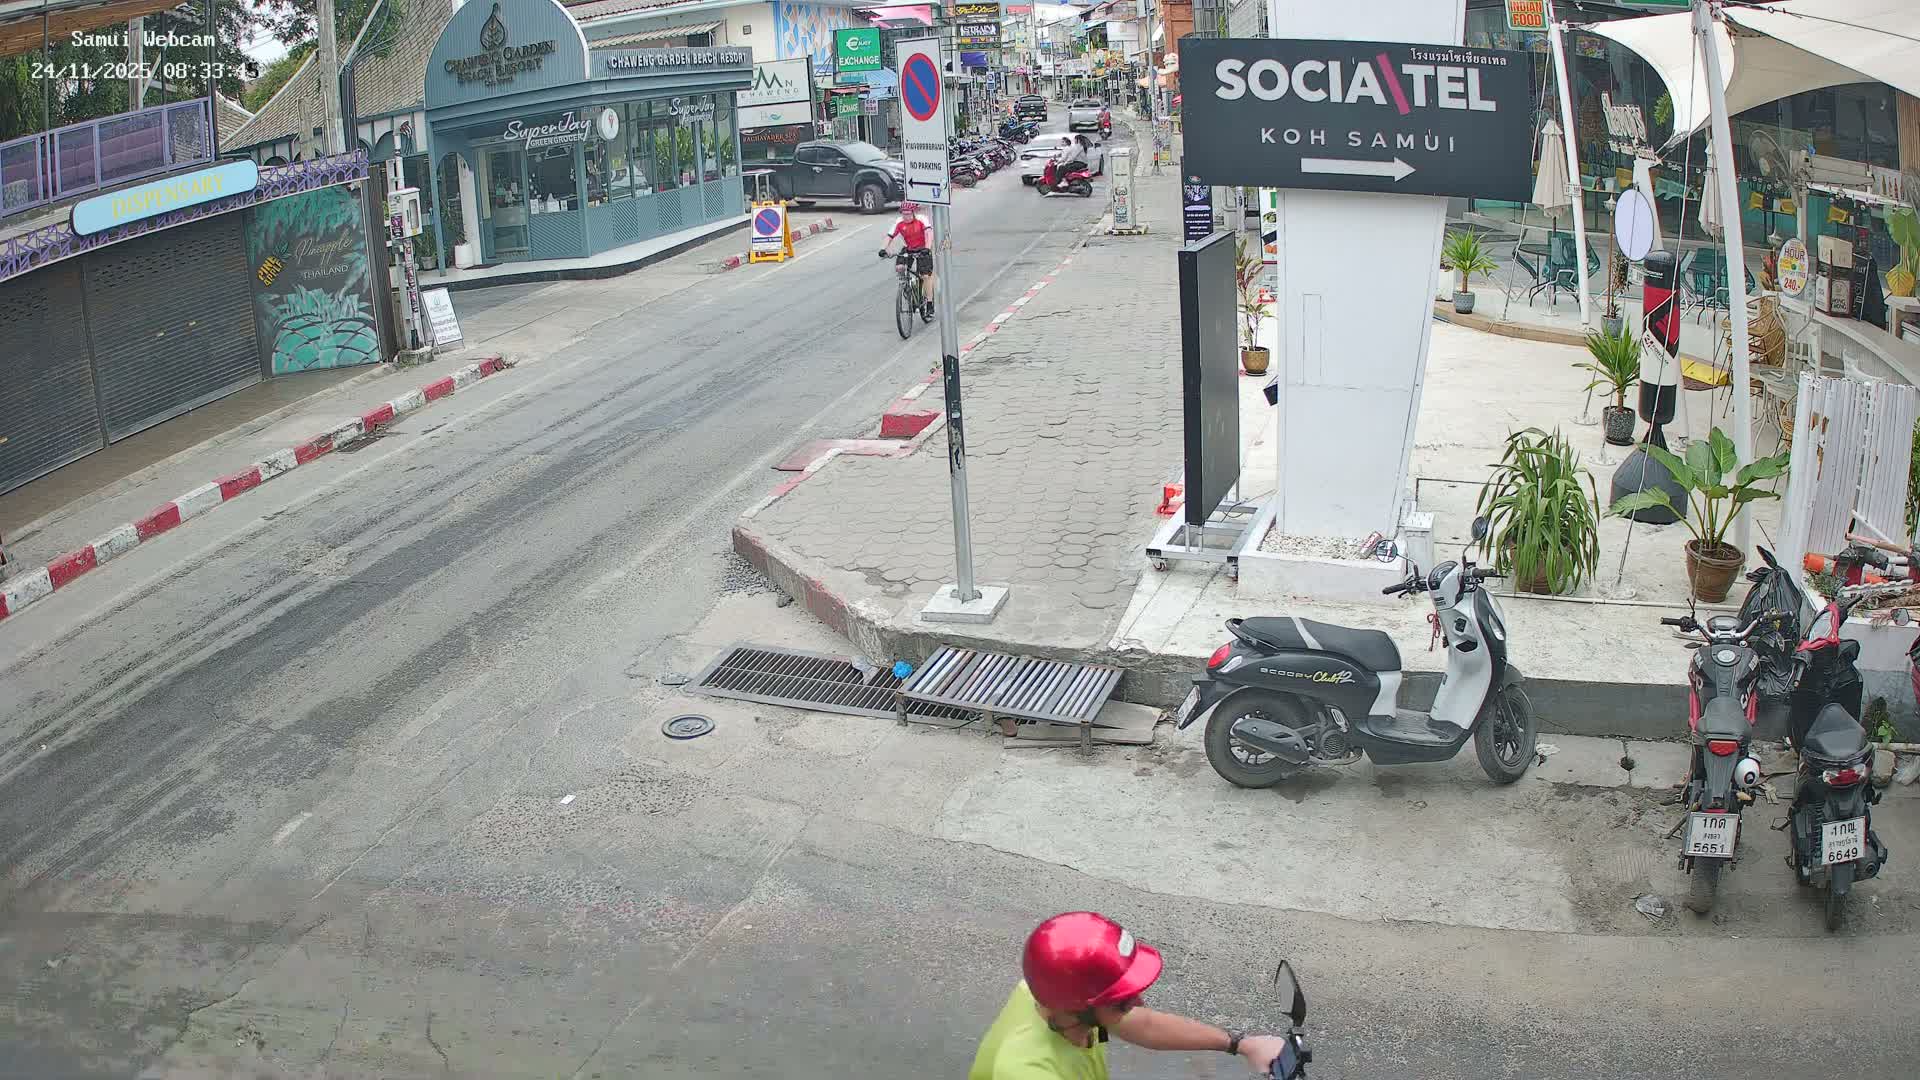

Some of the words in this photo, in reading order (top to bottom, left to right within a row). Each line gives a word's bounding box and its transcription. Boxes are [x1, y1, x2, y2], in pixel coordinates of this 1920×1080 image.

[1512, 13, 1542, 26] FOOD
[502, 40, 555, 60] GARDEN
[496, 58, 543, 77] RESORT
[611, 54, 655, 69] CHAWENG
[657, 52, 690, 66] GARDEN
[692, 51, 718, 65] BEACH
[720, 50, 746, 63] RESORT
[839, 55, 880, 66] EXCHANGE
[1260, 128, 1326, 146] KOH
[909, 161, 917, 170] NO
[918, 161, 942, 170] PARKING
[112, 174, 225, 221] DISPENSARY
[295, 229, 353, 265] Pineapple
[1784, 247, 1806, 262] HOUR
[257, 255, 279, 281] PINE
[303, 264, 349, 280] THAILAND
[1260, 667, 1313, 680] SCOOPY
[1693, 842, 1726, 854] 5651
[1828, 847, 1858, 862] 6649
